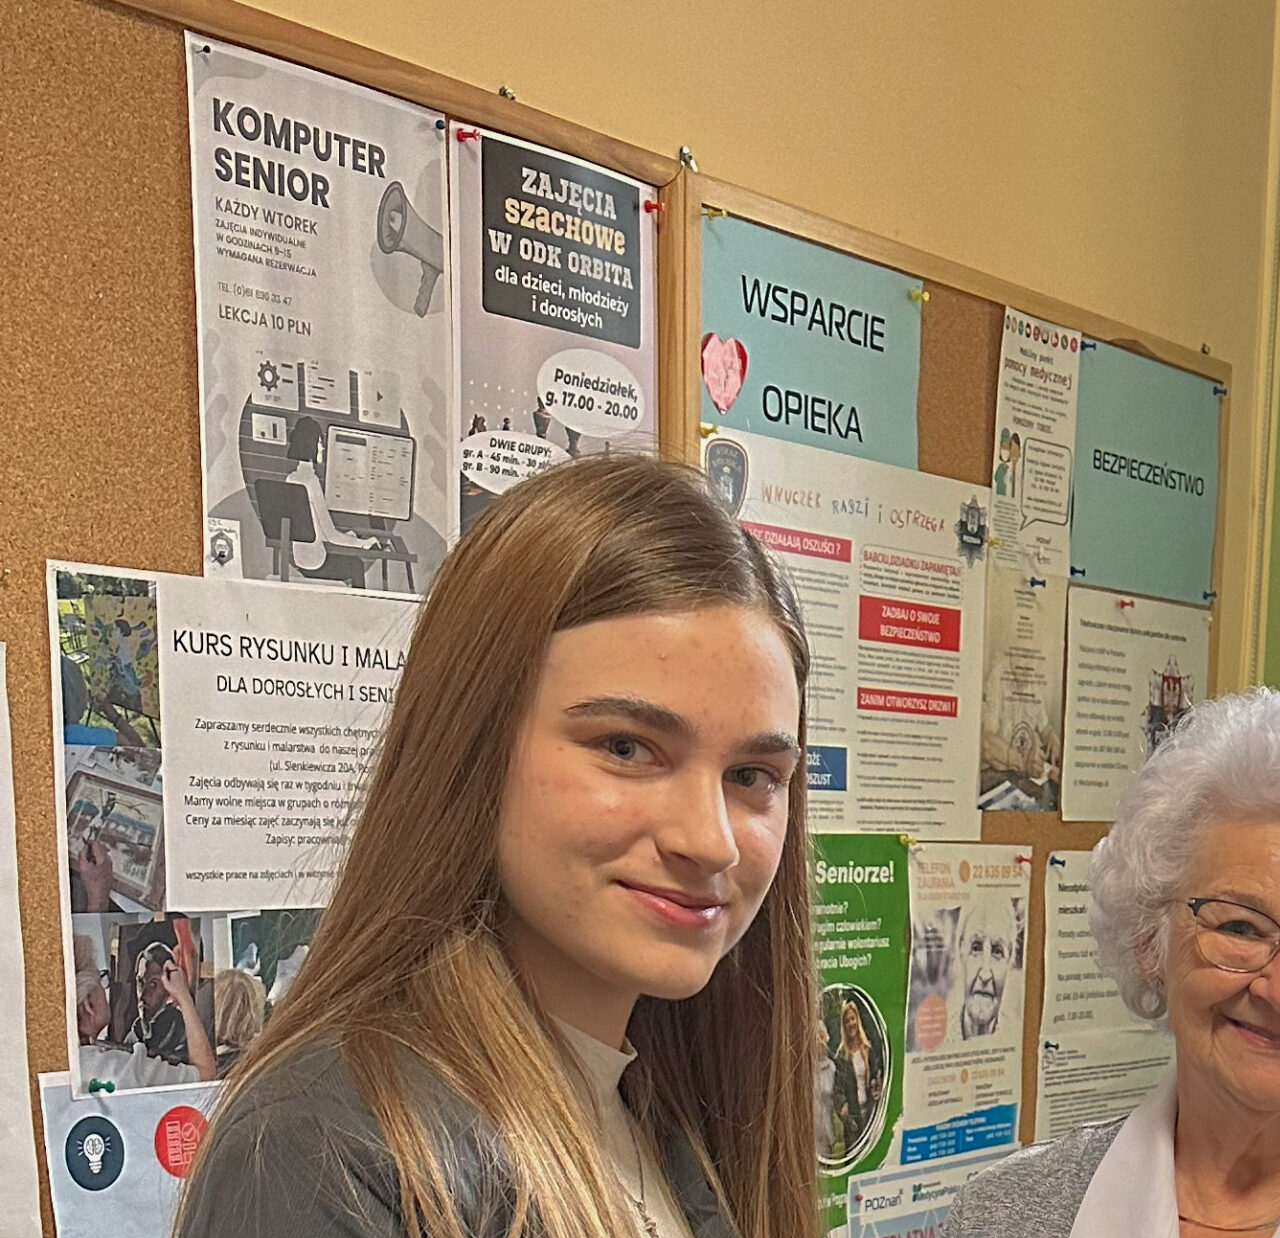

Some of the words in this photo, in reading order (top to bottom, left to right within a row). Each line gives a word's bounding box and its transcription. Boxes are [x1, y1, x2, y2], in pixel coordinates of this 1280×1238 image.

[212, 97, 386, 178] KOMPUTER
[214, 147, 330, 208] SENIOR
[521, 167, 617, 221] ZAJĘCIA
[215, 197, 259, 220] KAŻDY
[262, 208, 318, 236] WTOREK
[488, 229, 513, 255] W
[519, 238, 562, 269] ODK
[567, 251, 634, 290] ORBITA
[495, 265, 518, 285] dla
[521, 271, 566, 300] dzieci,
[568, 284, 629, 317] młodzieży
[219, 303, 269, 328] LEKCJA
[271, 314, 285, 331] 10
[288, 318, 311, 336] PLN
[532, 295, 537, 313] i
[540, 299, 603, 329] dorosłych
[741, 274, 885, 352] WSPARCIE
[554, 368, 638, 403] Poniedziałek,
[545, 391, 558, 407] g.
[562, 391, 595, 412] 17.00
[605, 401, 638, 421] 20.00
[762, 385, 863, 443] OPIEKA
[489, 437, 517, 452] DWIE
[1093, 449, 1204, 497] BEZPIECZEŃSTWO
[173, 629, 232, 657] KURS
[240, 636, 335, 665] RYSUNKU
[341, 645, 348, 667] I
[217, 675, 248, 694] DLA
[253, 678, 344, 701] DOROSŁYCH
[349, 685, 354, 700] I
[195, 718, 249, 733] Zapraszamy
[251, 723, 297, 735] serdecznie
[231, 740, 266, 752] rysunku
[272, 741, 316, 753] malarstwa
[189, 776, 222, 790] Zajęcia
[184, 795, 214, 810] Mamy
[216, 796, 243, 807] wolne
[185, 814, 210, 828] Ceny
[815, 860, 894, 884] Seniorze!
